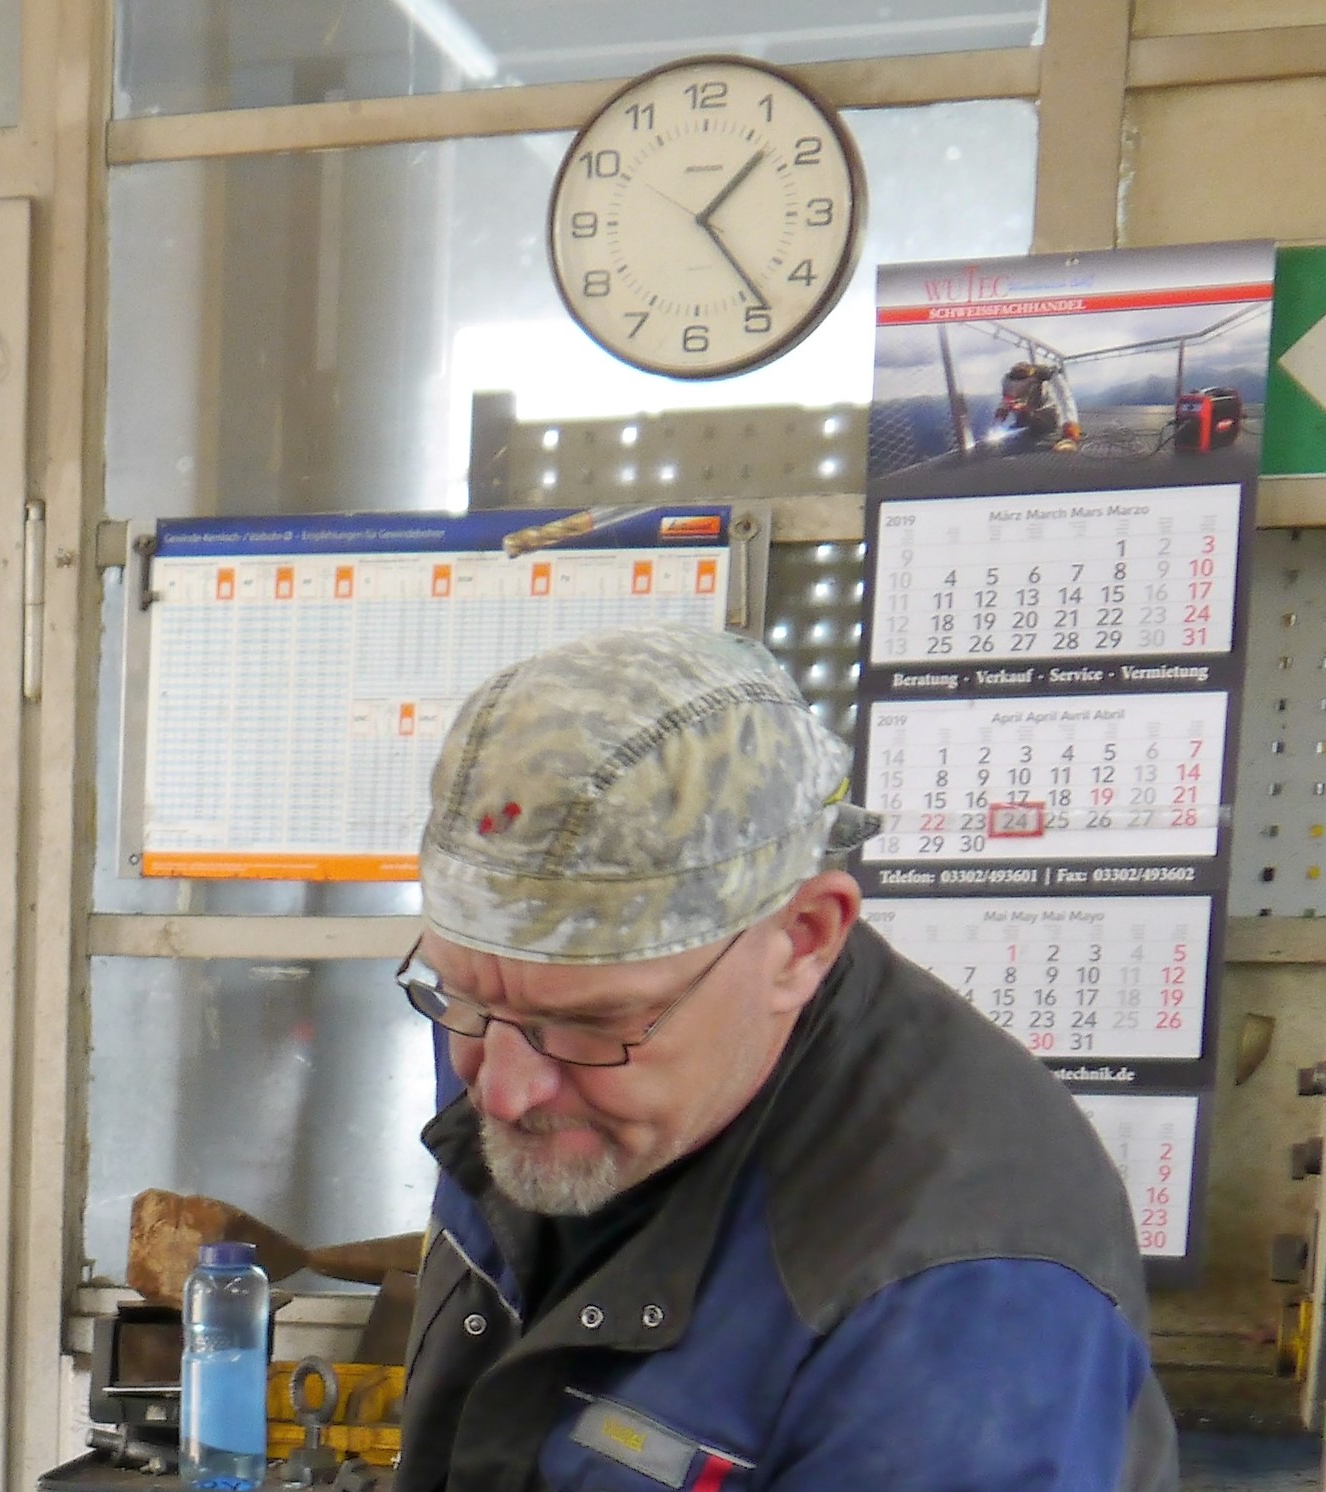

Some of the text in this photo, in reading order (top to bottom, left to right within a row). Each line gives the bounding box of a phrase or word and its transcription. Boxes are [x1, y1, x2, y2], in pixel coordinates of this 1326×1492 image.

[684, 82, 728, 108] 12
[625, 103, 655, 129] 11
[759, 94, 773, 121] 1
[794, 137, 821, 164] 2
[579, 151, 620, 177] 10
[807, 199, 833, 226] 3
[572, 212, 597, 237] 9
[583, 270, 610, 296] 8
[788, 259, 817, 285] 4
[744, 306, 771, 333] 5
[929, 300, 1087, 319] SCHWEISSFACHHANDEL
[624, 312, 648, 338] 7
[682, 326, 708, 351] 6
[885, 515, 916, 527] 2019
[1117, 540, 1125, 557] 1
[1158, 538, 1171, 556] 2
[1203, 536, 1215, 554] 3
[944, 570, 956, 586] 4
[986, 568, 998, 586] 5
[1029, 566, 1040, 584] 6
[1072, 564, 1084, 582] 7
[1114, 562, 1126, 580] 8
[1158, 560, 1170, 579] 9
[1189, 559, 1214, 576] 10
[934, 592, 953, 609] 11
[975, 590, 997, 608] 12
[1017, 588, 1039, 606] 13
[1059, 587, 1082, 604] 14
[1102, 585, 1124, 603] 15
[1145, 584, 1168, 602] 16
[1188, 581, 1212, 600] 17
[932, 614, 954, 631] 18
[974, 613, 996, 630] 19
[1012, 611, 1038, 629] 20
[1054, 610, 1078, 627] 21
[1097, 608, 1123, 626] 22
[1139, 606, 1166, 626] 23
[1184, 605, 1210, 623] 24
[927, 636, 952, 654] 25
[969, 635, 994, 653] 26
[1011, 633, 1036, 651] 27
[1053, 632, 1079, 650] 28
[1096, 630, 1122, 648] 29
[1138, 629, 1165, 648] 30
[1182, 628, 1206, 646] 31
[892, 666, 1208, 688] Beratung Verkauf Service Vermietung
[877, 715, 908, 727] 2019
[992, 713, 1023, 724] April
[1026, 711, 1058, 723] April
[939, 748, 947, 765] 1
[979, 747, 990, 764] 2
[1020, 746, 1032, 763] 3
[1061, 745, 1074, 761] 4
[1104, 744, 1116, 761] 5
[1146, 742, 1158, 760] 6
[1191, 740, 1202, 758] 7
[936, 770, 948, 787] 8
[978, 769, 989, 786] 9
[1008, 768, 1031, 785] 10
[1051, 767, 1070, 784] 11
[1092, 766, 1115, 783] 12
[1135, 764, 1158, 782] 13
[1177, 764, 1200, 780] 14
[925, 792, 946, 809] 15
[966, 792, 988, 808] 16
[1008, 791, 1030, 805] 17
[1049, 789, 1071, 806] 18
[1090, 788, 1114, 805] 19
[1130, 787, 1158, 807] 20
[1173, 786, 1196, 804] 21
[919, 814, 945, 832] 22
[961, 814, 986, 830] 23
[1001, 813, 1030, 831] 24
[1045, 812, 1069, 828] 25
[1086, 811, 1112, 830] 26
[1126, 809, 1155, 829] 27
[1170, 809, 1197, 828] 28
[919, 835, 944, 853] 29
[960, 834, 987, 852] 30
[880, 870, 935, 883] Telefon:
[1058, 869, 1087, 881] Fax:
[984, 912, 1008, 921] Mai
[1012, 912, 1037, 924] May
[1042, 912, 1067, 921] Mai
[1008, 944, 1186, 963] 1 2 3 4 5
[965, 966, 1185, 985] 7 8 9 10 11 12
[993, 988, 1015, 1006] 15
[1035, 989, 1056, 1006] 16
[1076, 989, 1099, 1006] 17
[1117, 989, 1141, 1007] 18
[1161, 989, 1183, 1007] 19
[1029, 1011, 1055, 1028] 23
[1071, 1011, 1097, 1028] 24
[1112, 1011, 1139, 1029] 25
[1156, 1011, 1181, 1029] 26
[1029, 1033, 1093, 1050] 30 31
[1161, 1143, 1173, 1159] 2
[1159, 1165, 1171, 1181] 9
[1148, 1187, 1169, 1203] 16
[1142, 1209, 1167, 1225] 23
[1140, 1231, 1166, 1248] 30
